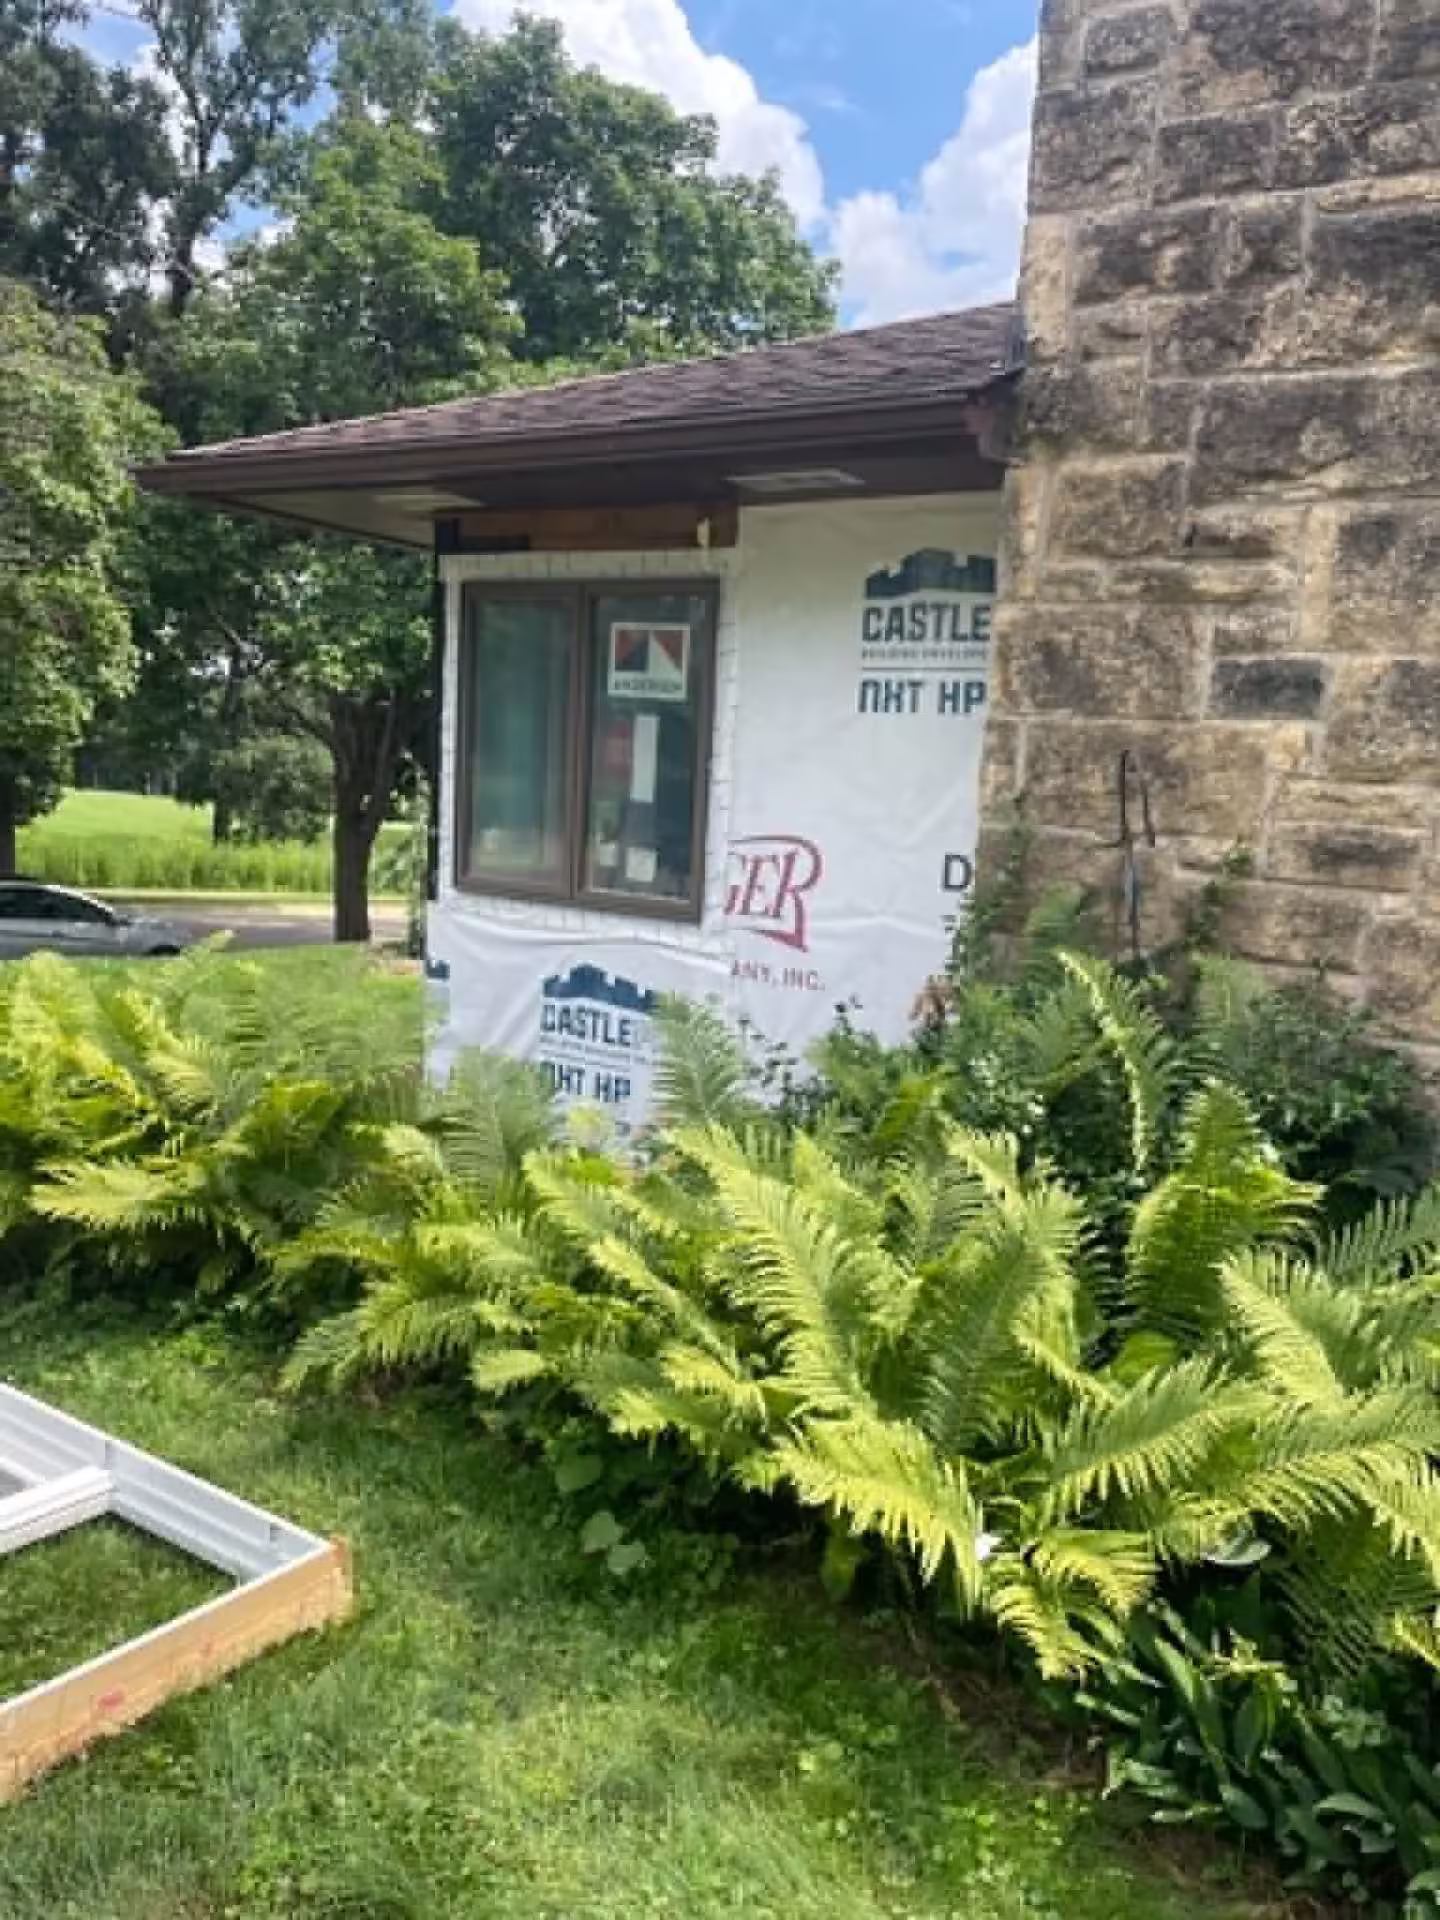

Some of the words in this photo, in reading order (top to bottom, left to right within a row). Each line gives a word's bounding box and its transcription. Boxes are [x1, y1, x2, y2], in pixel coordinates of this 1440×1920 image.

[862, 602, 991, 642] CASTLE
[938, 681, 986, 714] HP
[540, 1003, 631, 1048] CASTLE
